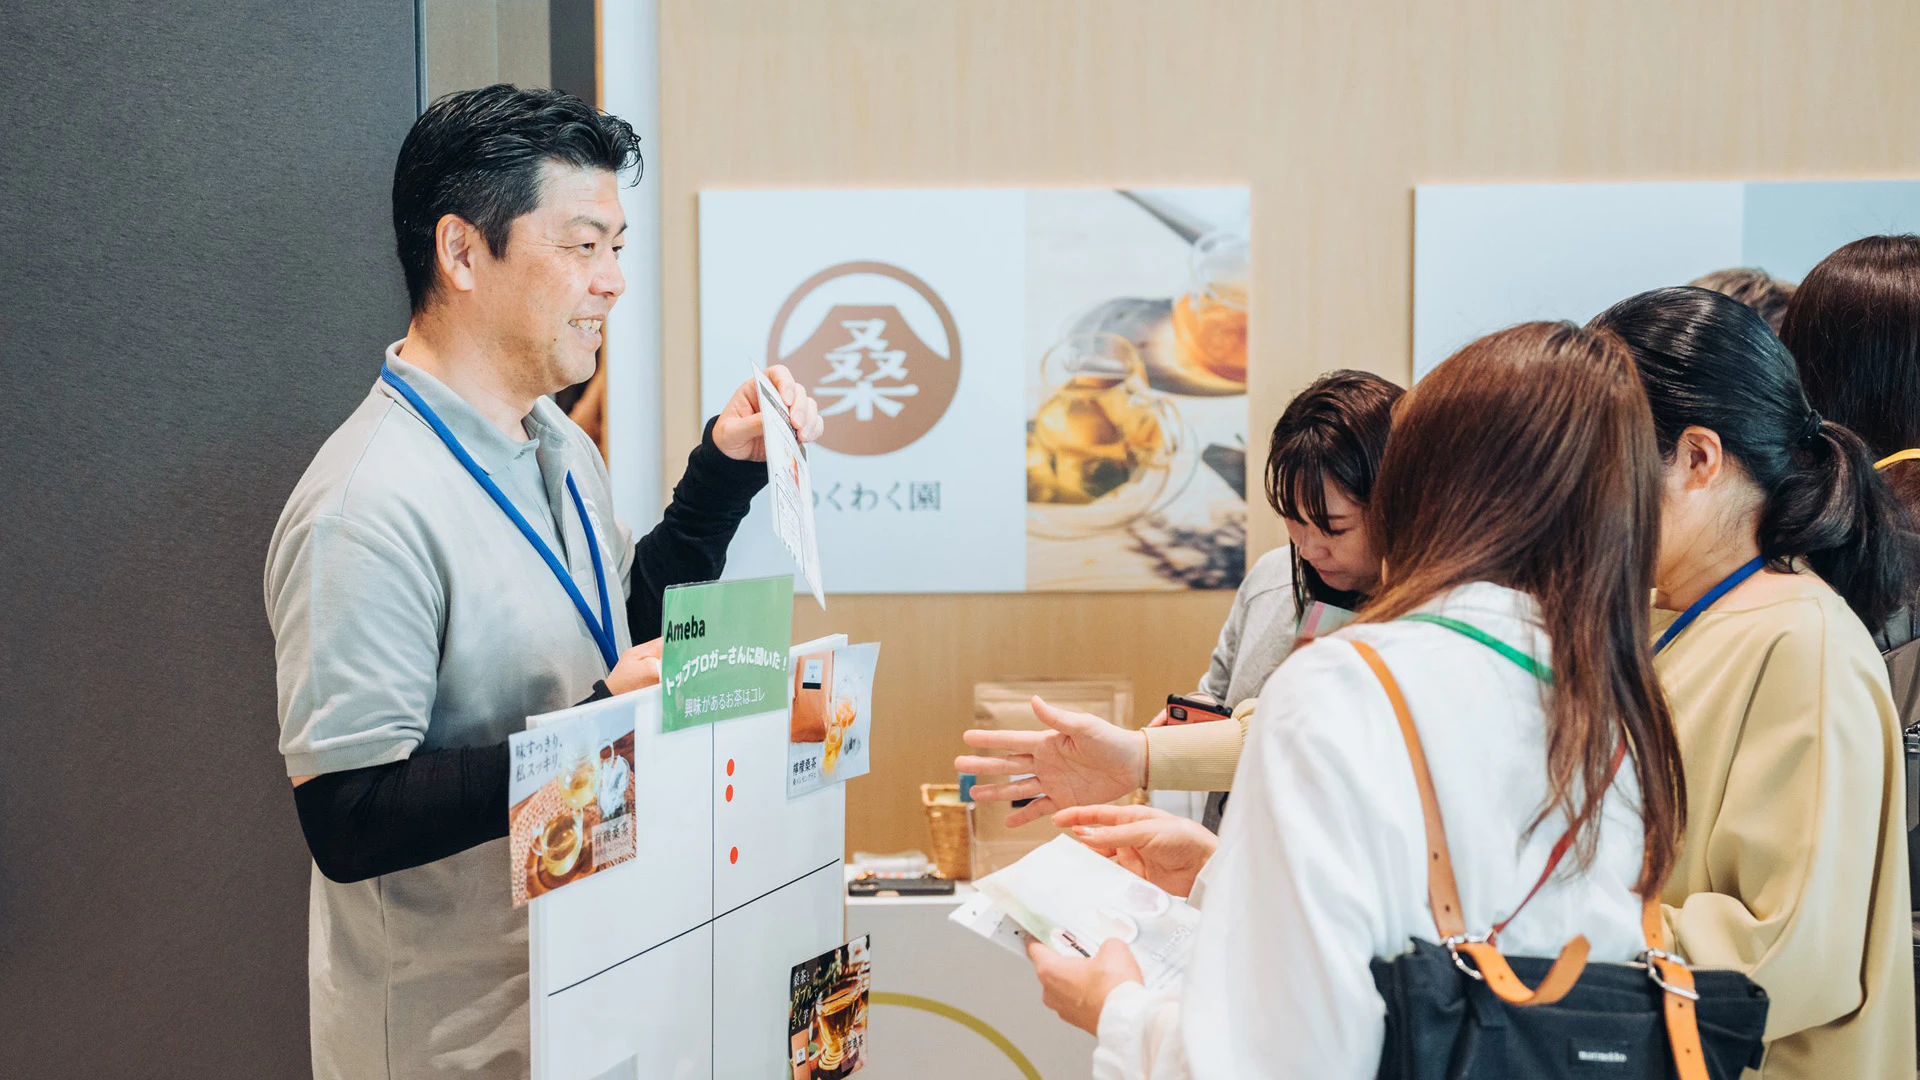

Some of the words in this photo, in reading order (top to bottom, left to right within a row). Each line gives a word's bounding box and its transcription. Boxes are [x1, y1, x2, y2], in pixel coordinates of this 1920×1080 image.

[813, 318, 919, 421] 桑
[812, 480, 941, 512] くわく園
[666, 615, 706, 643] Ameba
[684, 687, 765, 718] 興味があるお茶はコレ
